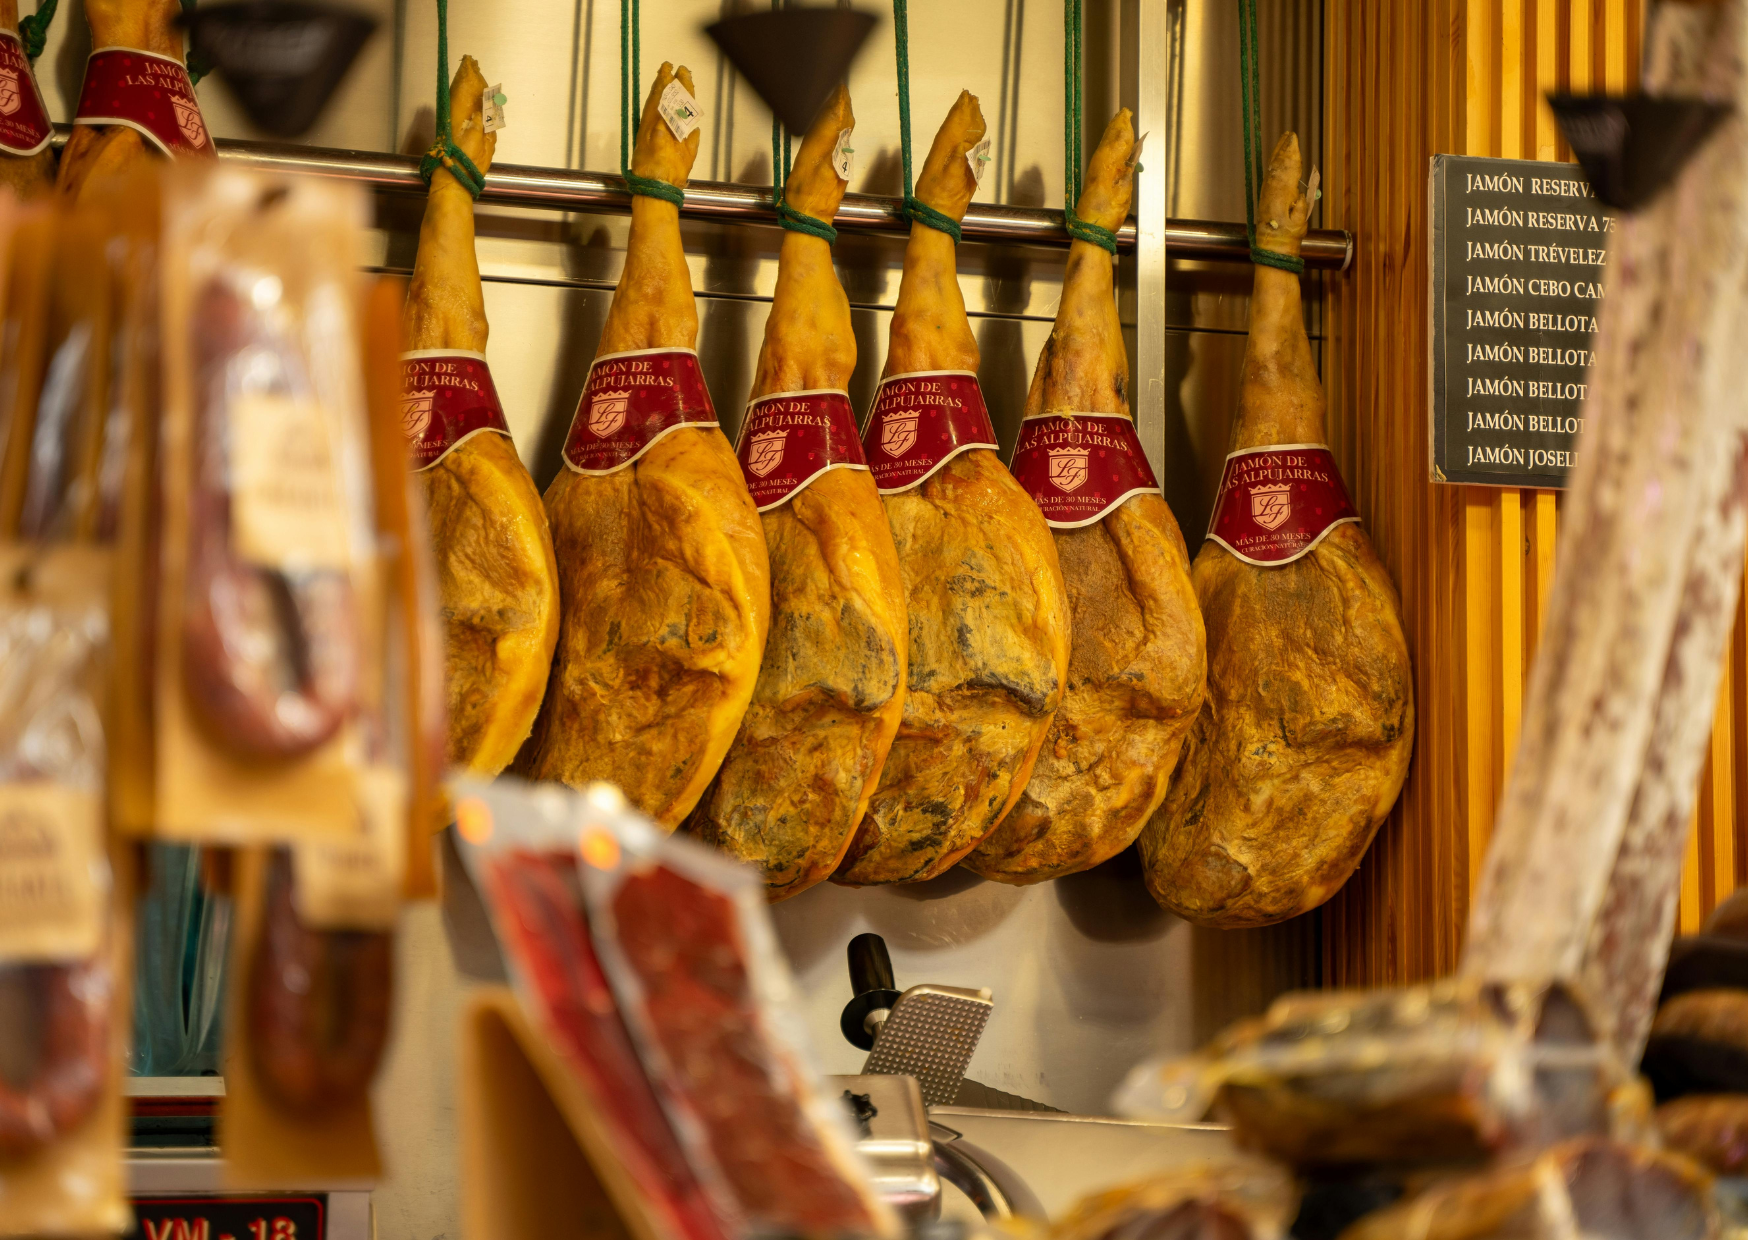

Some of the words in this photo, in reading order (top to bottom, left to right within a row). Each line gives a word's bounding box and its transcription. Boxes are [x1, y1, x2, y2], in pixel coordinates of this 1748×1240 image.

[126, 75, 155, 86] LAS
[684, 106, 694, 117] 4
[842, 161, 848, 174] 4
[1466, 172, 1524, 194] JAMÓN
[1531, 178, 1598, 198] RESERV
[1466, 206, 1524, 227] JAMÓN
[1528, 211, 1600, 232] RESERVA
[1466, 240, 1524, 262] JAMÓN
[1528, 243, 1606, 266] TRÉVELEZ
[1466, 274, 1524, 295] JAMÓN
[1528, 279, 1571, 297] CEBO
[1466, 308, 1524, 330] JAMÓN
[1528, 312, 1600, 332] BELLOTA
[1466, 342, 1524, 363] JAMÓN
[1528, 347, 1598, 366] BELLOTA
[434, 362, 457, 374] DE
[592, 361, 628, 380] AMÓN
[632, 362, 653, 372] DE
[403, 374, 479, 391] PUJARRAS
[589, 374, 674, 392] ALPUJARRAS
[880, 381, 916, 400] AMÓN
[920, 382, 941, 392] DE
[1466, 376, 1524, 398] JAMÓN
[1528, 381, 1589, 400] BELLOT
[750, 401, 786, 420] AMÓN
[790, 402, 810, 412] DE
[878, 394, 962, 412] ALPUJARRAS
[1087, 421, 1108, 434] DE
[1467, 410, 1524, 432] JAMÓN
[611, 440, 640, 450] MESES
[1016, 437, 1038, 455] LAS
[1040, 432, 1128, 452] ALPUJARRAS
[1468, 444, 1525, 466] JAMÓN
[871, 464, 880, 473] ÁS
[880, 462, 892, 470] DE
[904, 458, 932, 468] MESES
[1234, 454, 1282, 476] JAMÓN
[1286, 456, 1308, 467] DE
[769, 478, 798, 486] MESES
[1220, 476, 1238, 494] LAS
[1241, 468, 1329, 484] ALPUJARRAS
[1041, 504, 1071, 512] URACIÓN
[1050, 496, 1065, 504] DE
[1078, 496, 1106, 504] MESES
[1235, 536, 1254, 546] MÁS
[1256, 535, 1269, 543] DE
[1282, 532, 1311, 540] MESES
